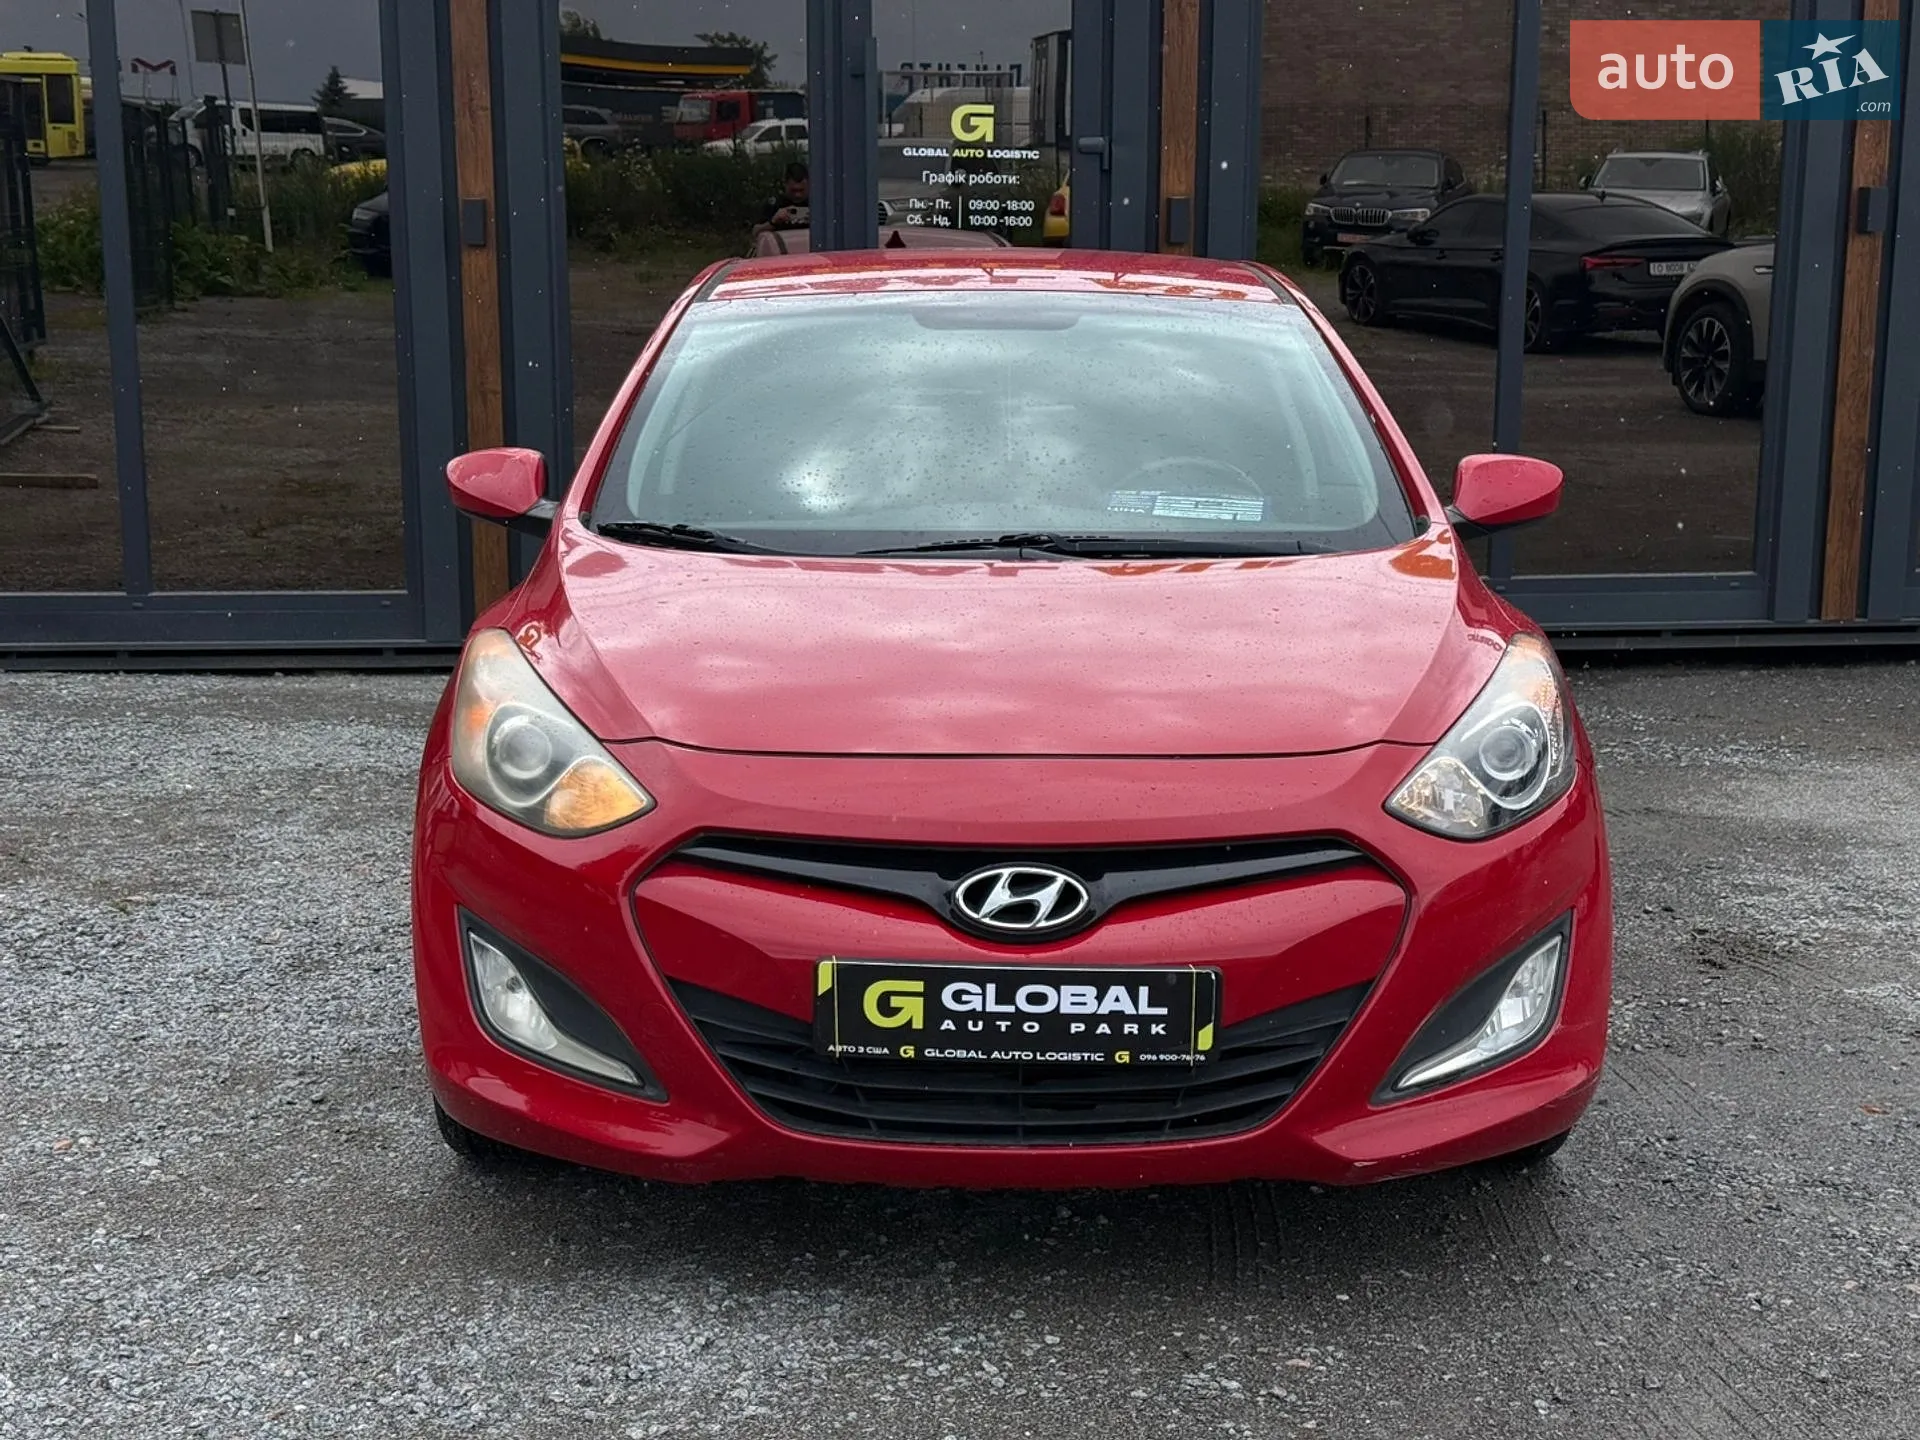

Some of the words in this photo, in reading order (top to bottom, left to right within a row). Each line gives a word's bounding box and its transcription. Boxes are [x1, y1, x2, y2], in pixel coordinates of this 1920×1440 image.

[902, 147, 949, 157] GLOBAL
[952, 148, 985, 159] AUTO
[987, 149, 1040, 159] LOGISTIC
[922, 170, 966, 185] Графік
[969, 171, 1020, 186] роботи:
[909, 198, 927, 209] Пн.
[935, 198, 952, 209] Пт.
[968, 199, 1000, 211] 09:00
[906, 213, 925, 225] Сб.
[934, 214, 951, 227] Нд.
[968, 215, 998, 226] 10:00
[941, 982, 1168, 1015] GLOBAL
[940, 1019, 1040, 1033] AUTO
[1070, 1022, 1166, 1035] PARK
[865, 1046, 890, 1055] США
[924, 1048, 988, 1059] GLOBAL
[990, 1050, 1034, 1060] AUTO
[1036, 1051, 1105, 1062] LOGISTIC
[1139, 1053, 1158, 1061] 096
